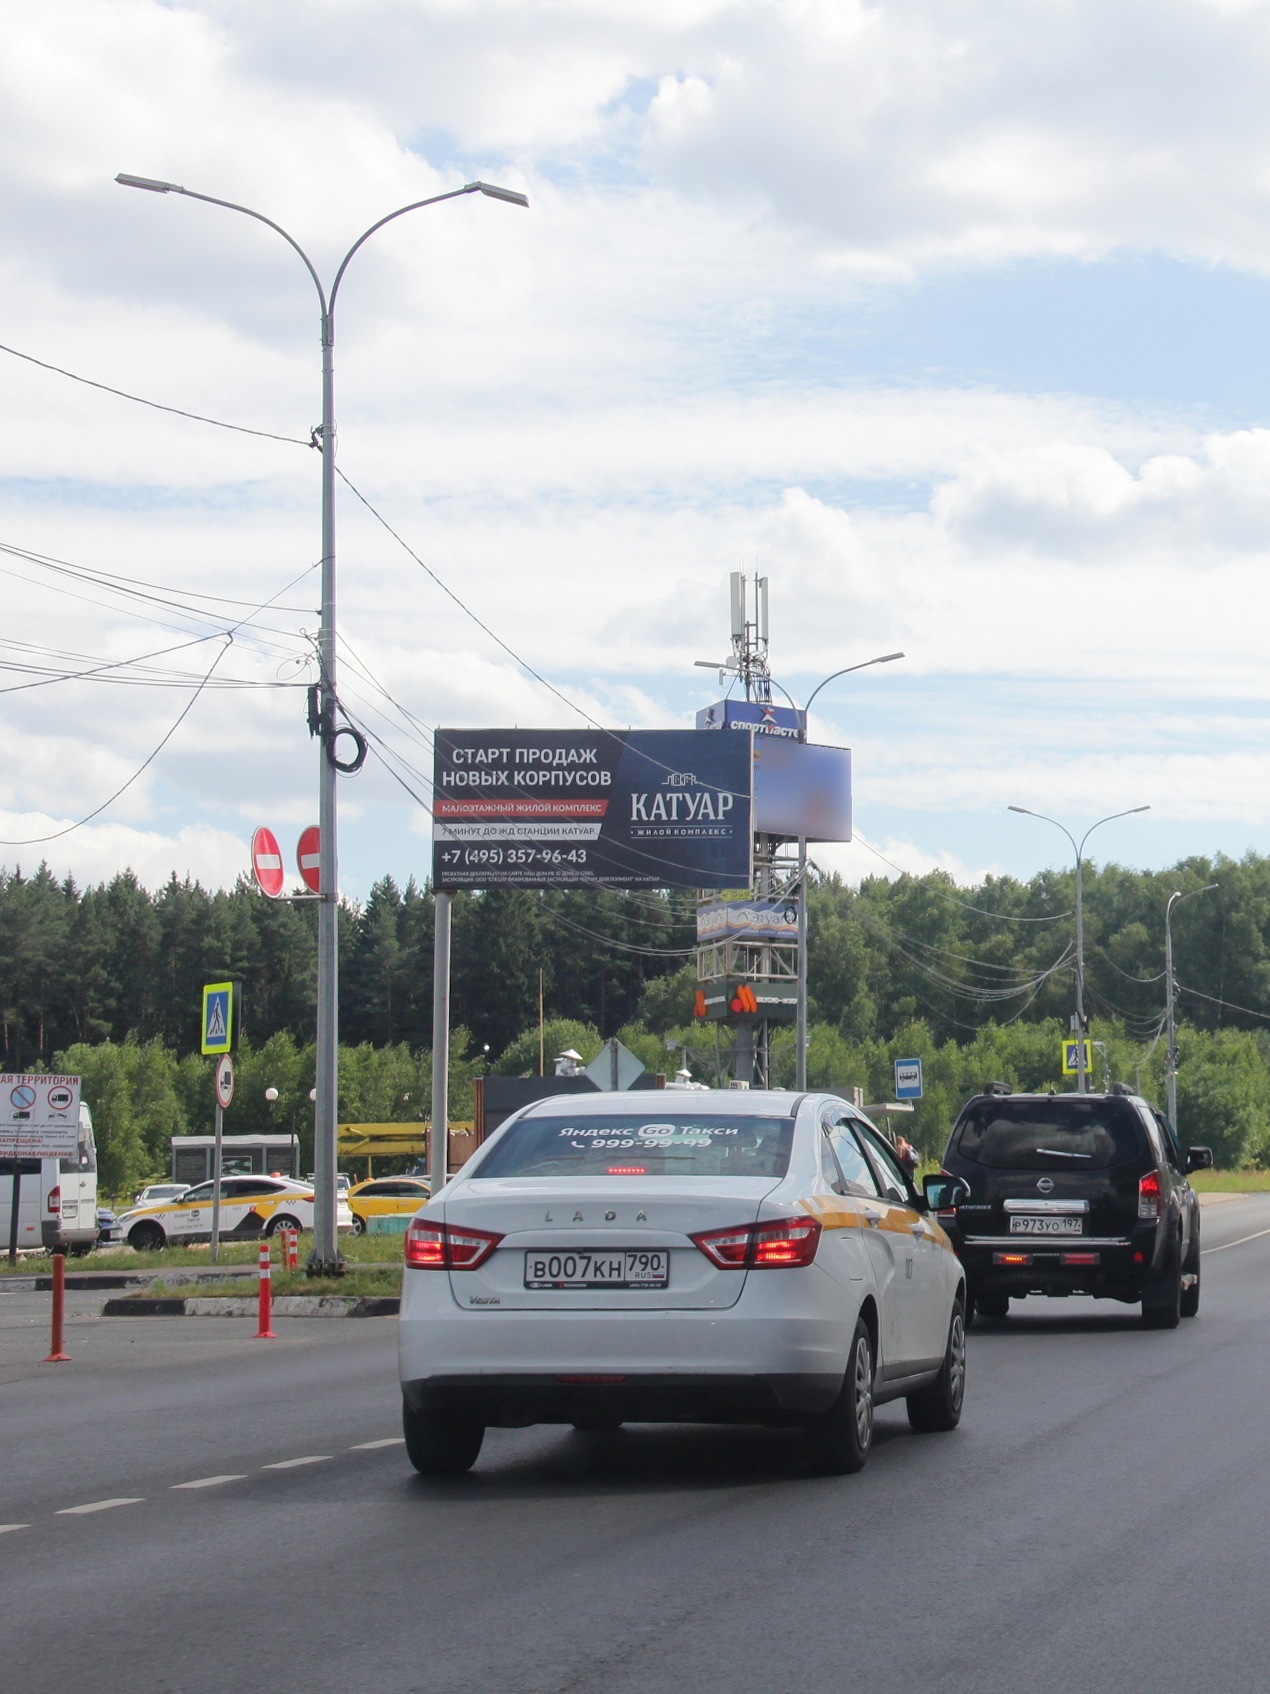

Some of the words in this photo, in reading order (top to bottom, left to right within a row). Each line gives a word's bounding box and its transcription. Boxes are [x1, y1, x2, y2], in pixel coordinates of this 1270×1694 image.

[730, 720, 807, 739] спортмасте
[452, 748, 511, 764] СТАРТ
[515, 748, 597, 767] ПРОДАЖ
[442, 770, 509, 786] НОВЫХ
[513, 770, 612, 786] КОРПУСОВ
[441, 803, 515, 813] МАЛОЭТАЖНЫЙ
[516, 803, 551, 812] ЖИЛОЙ
[552, 804, 602, 812] КОМПЛЕКС
[630, 792, 734, 821] КАТУАР
[449, 827, 482, 836] МИНУТ
[483, 827, 498, 837] ДО
[499, 827, 516, 837] ЖД
[517, 827, 560, 837] СТАНЦИИ
[561, 827, 595, 836] КАТУАР
[637, 827, 672, 836] ЖИЛОЙ
[673, 827, 726, 835] КОМПЛЕКС
[441, 850, 461, 864] +7
[464, 848, 504, 865] (495)
[506, 849, 587, 864] 357-96-43
[0, 1075, 13, 1084] АЯ
[16, 1075, 79, 1086] ТЕРРИТОРИЯ
[558, 1127, 634, 1137] Яндекс
[644, 1126, 671, 1136] Go
[680, 1126, 739, 1136] Такси
[590, 1138, 713, 1149] 999-99-99
[545, 1210, 648, 1223] LADA
[1062, 1218, 1079, 1229] 197
[533, 1255, 622, 1279] В007КН
[627, 1254, 661, 1272] 790
[634, 1271, 652, 1279] RUS
